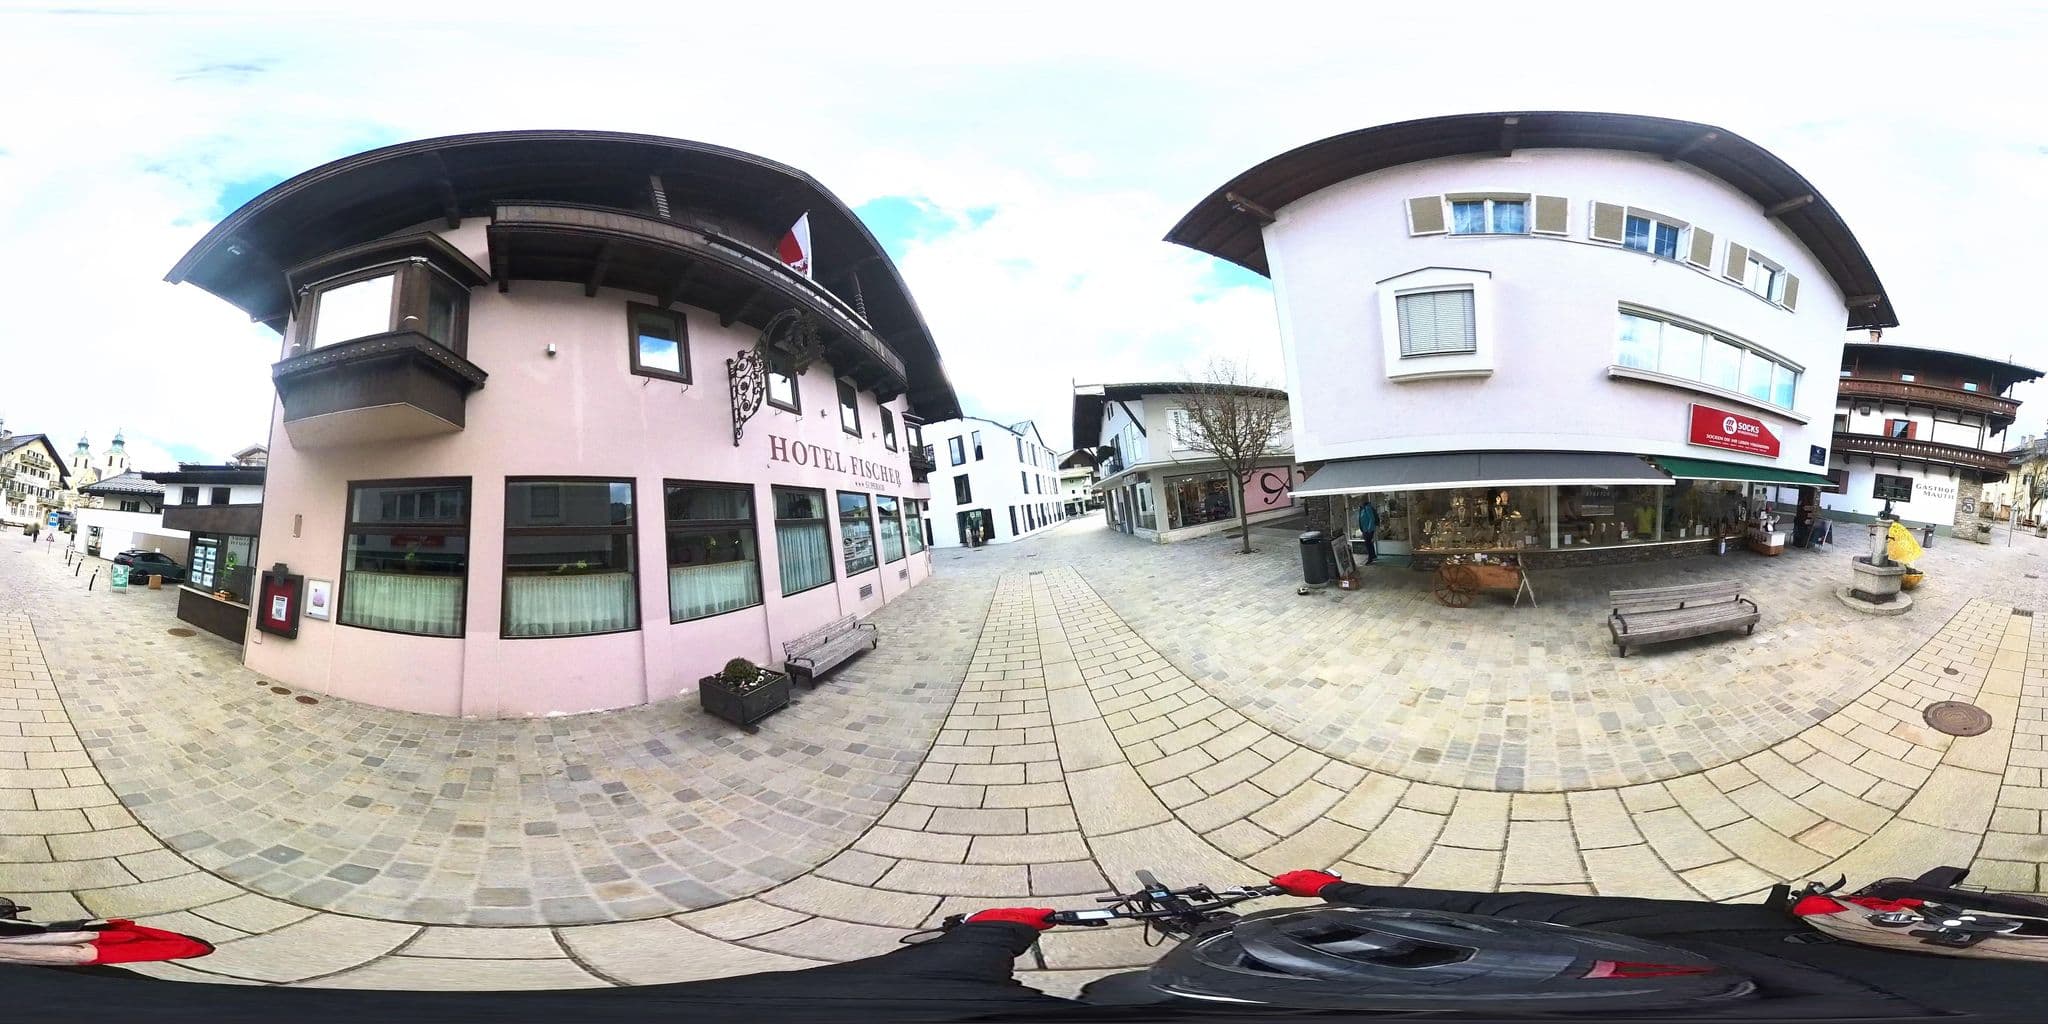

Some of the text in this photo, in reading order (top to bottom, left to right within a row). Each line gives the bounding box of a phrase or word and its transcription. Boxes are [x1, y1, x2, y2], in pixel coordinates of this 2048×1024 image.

[1738, 422, 1760, 433] SOCKS
[768, 434, 901, 485] HOTEL FISCHER
[1916, 484, 1955, 493] GASTHOF
[1923, 491, 1954, 499] MAUTH
